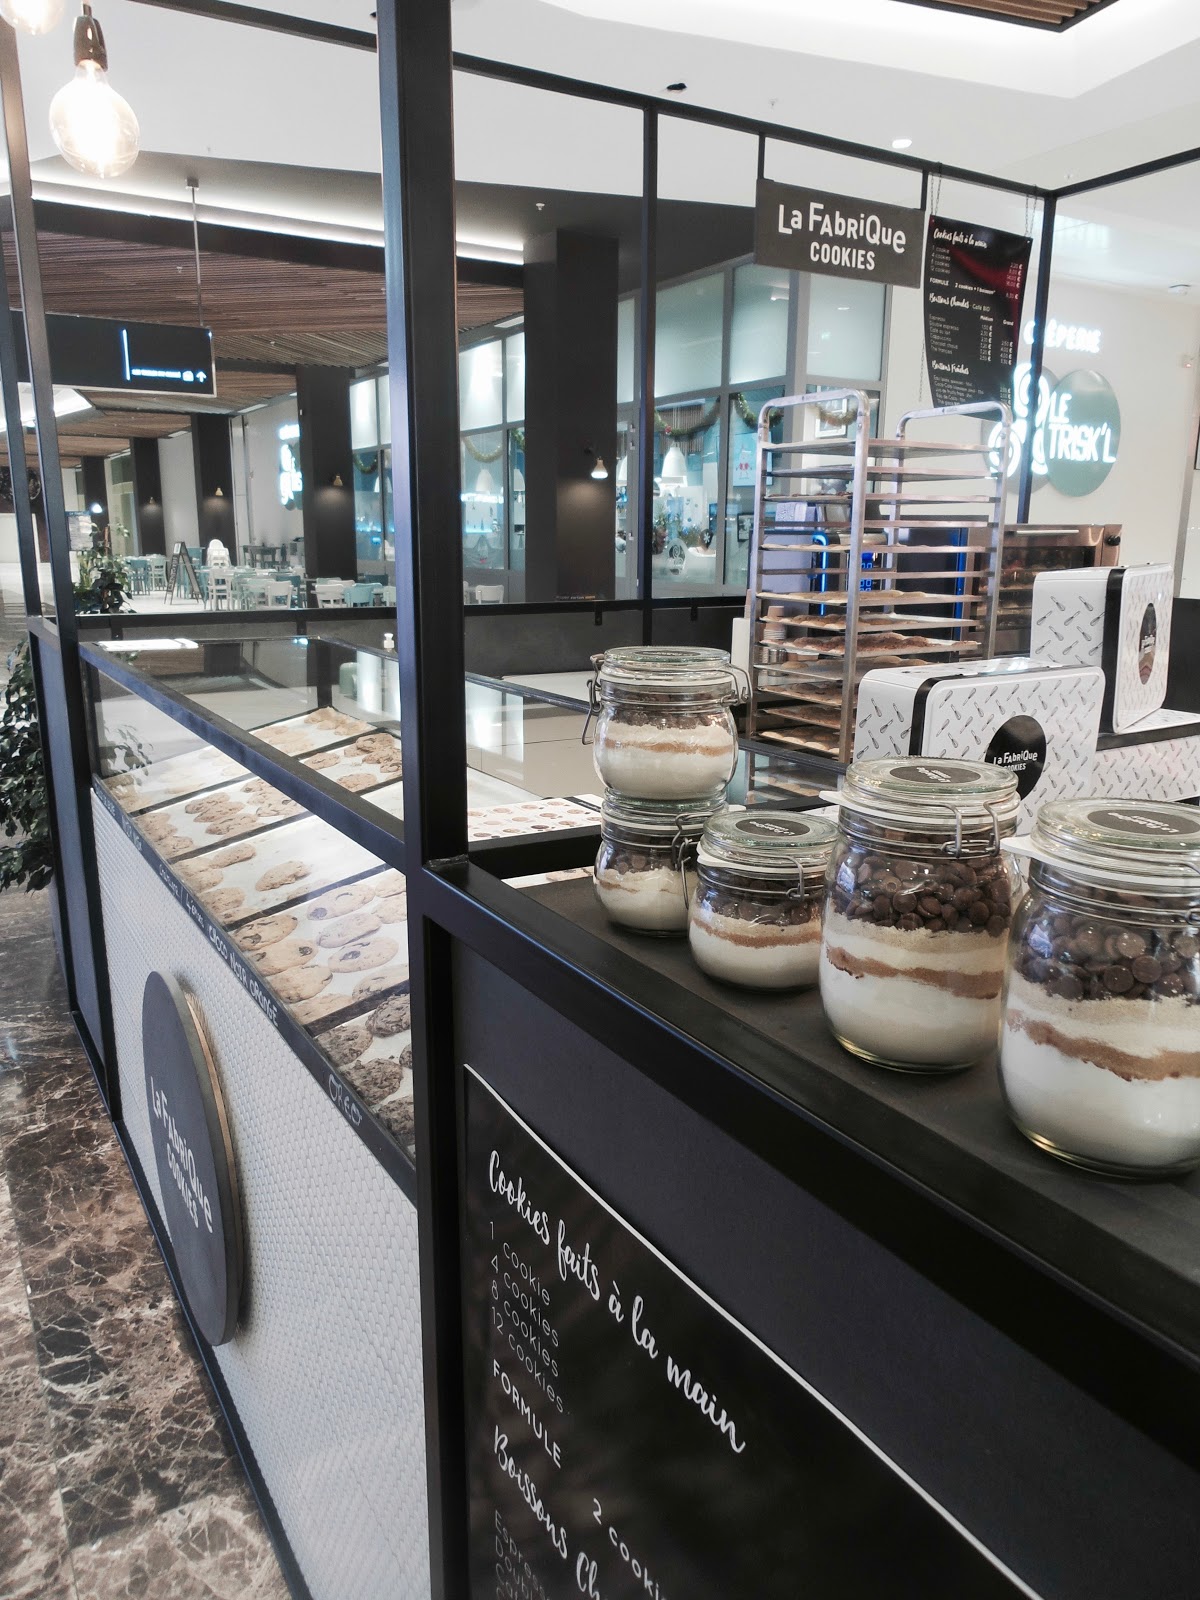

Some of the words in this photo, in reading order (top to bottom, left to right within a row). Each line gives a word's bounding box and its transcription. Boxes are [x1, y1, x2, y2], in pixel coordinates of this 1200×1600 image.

[778, 204, 802, 235] La
[810, 242, 875, 270] COOKIES
[1049, 391, 1072, 424] LE
[1049, 422, 1116, 463] TRISK'L
[167, 1143, 198, 1228] COOKIES
[489, 1150, 550, 1245] Cookies
[558, 1219, 600, 1300] faits
[608, 1280, 624, 1322] à
[632, 1295, 658, 1359] la
[667, 1355, 746, 1453] main
[490, 1221, 494, 1240] 1
[503, 1242, 550, 1306] cookie
[491, 1255, 498, 1273] 4
[504, 1272, 559, 1347] cookies
[492, 1280, 498, 1300] 8
[504, 1301, 559, 1377] cookies
[492, 1306, 503, 1335] 12
[508, 1334, 564, 1413] cookies
[493, 1358, 561, 1468] FORMULE
[593, 1498, 602, 1525] 2
[494, 1425, 567, 1560] Boissons
